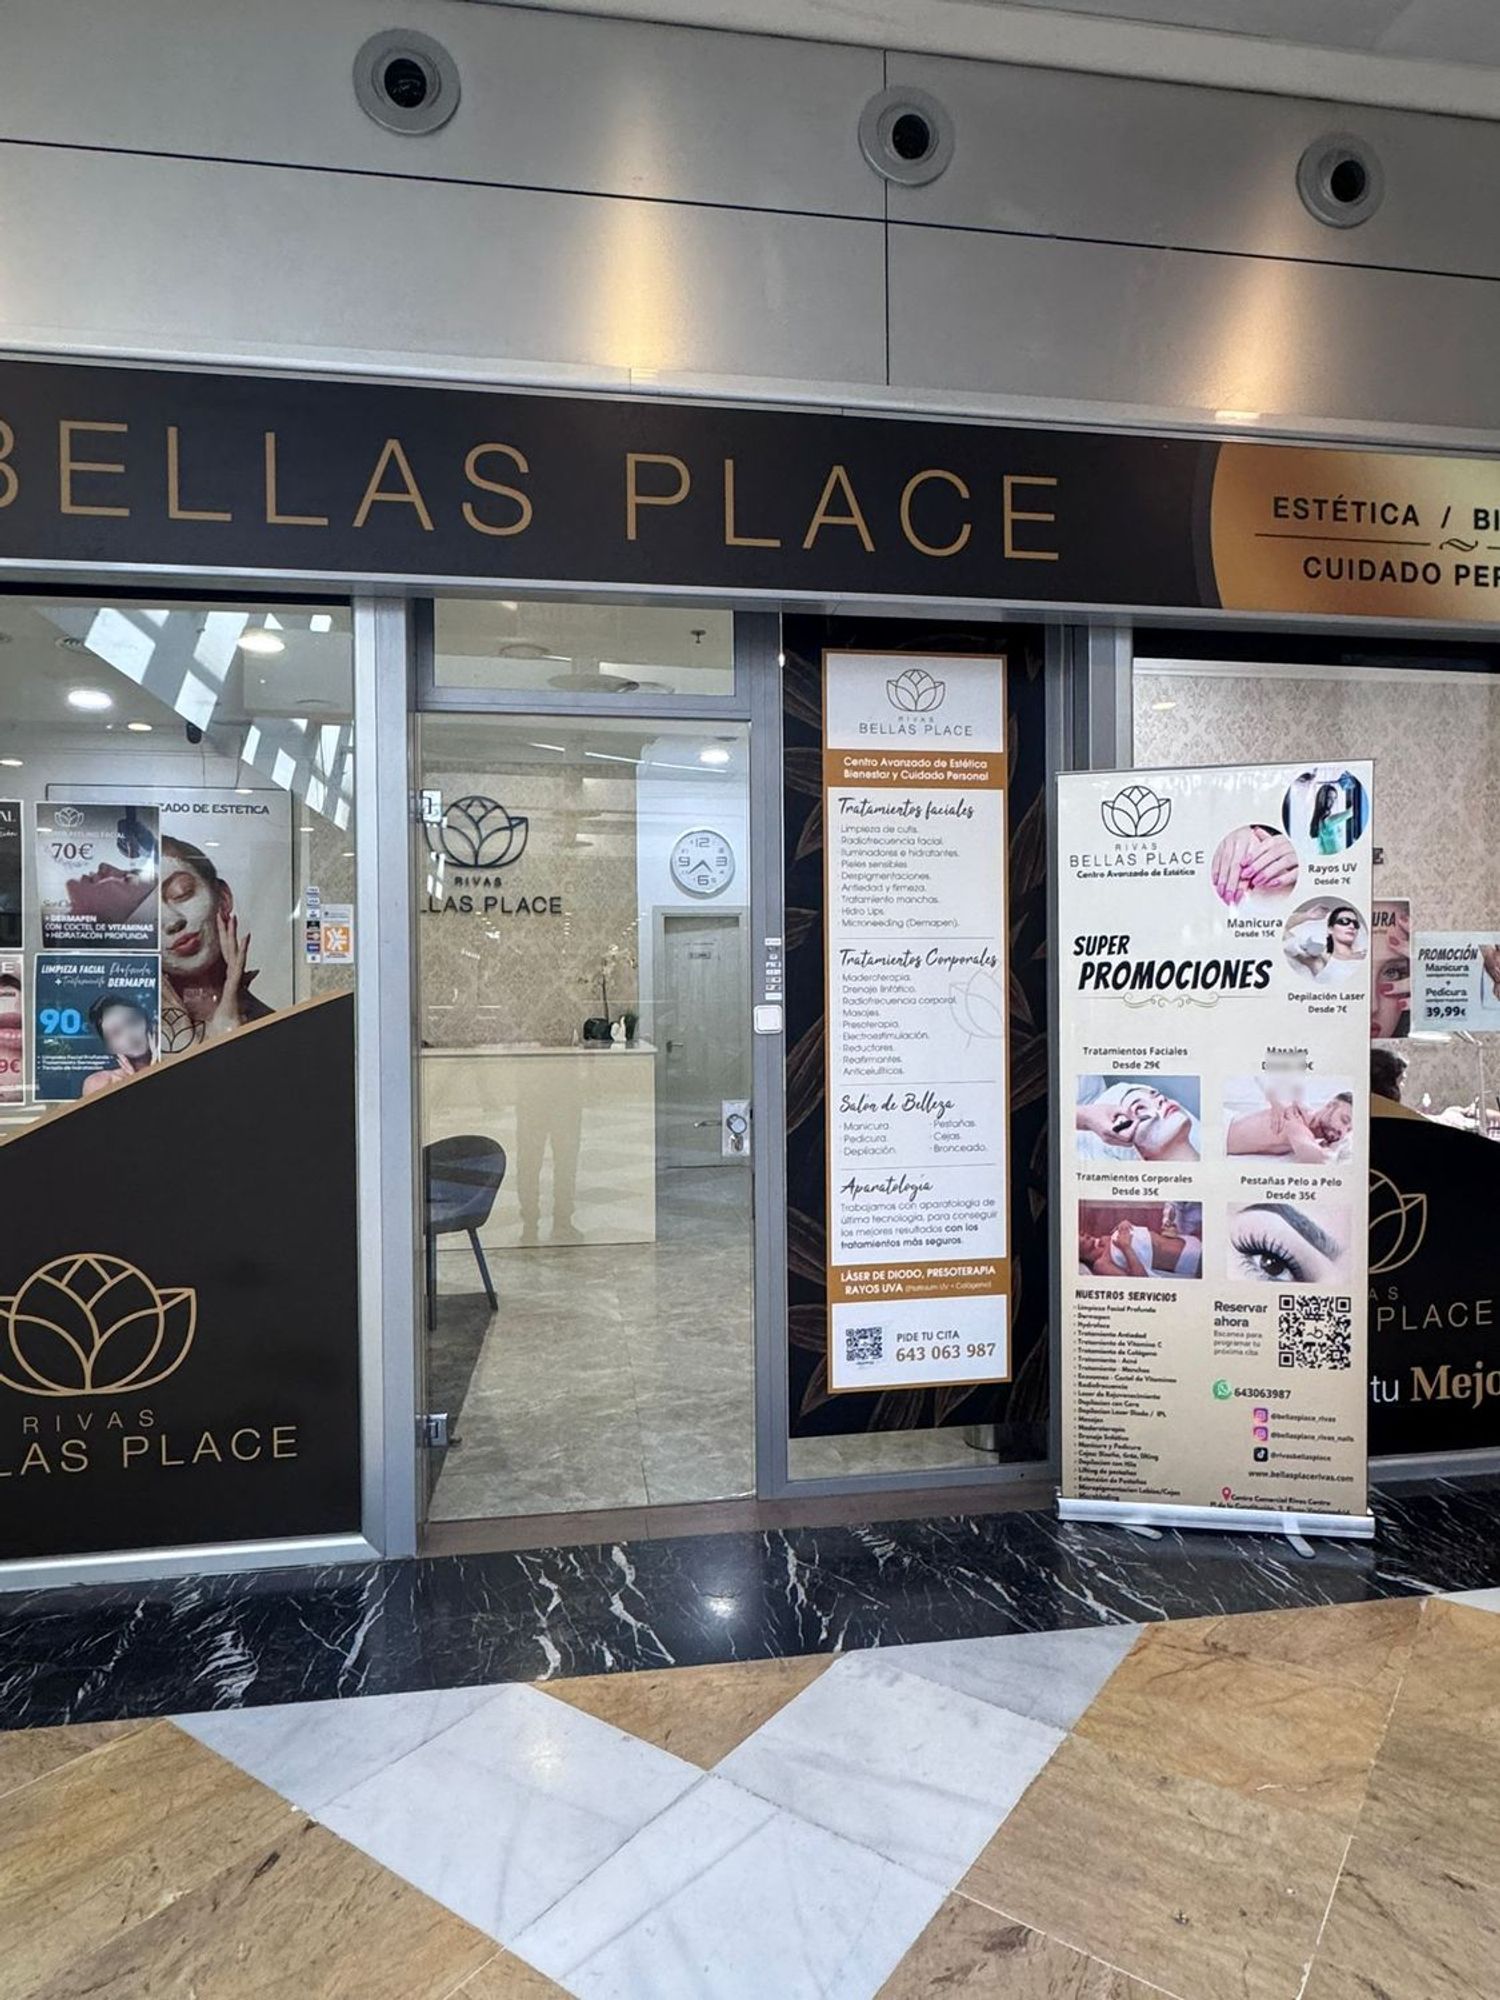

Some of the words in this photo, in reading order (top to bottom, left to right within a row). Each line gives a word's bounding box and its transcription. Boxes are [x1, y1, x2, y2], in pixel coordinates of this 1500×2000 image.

[626, 452, 1059, 560] PLACE
[1273, 494, 1420, 527] ESTÉTICA
[1303, 556, 1441, 585] CUIDADO
[859, 722, 917, 736] BELLAS
[924, 725, 973, 737] PLACE
[843, 757, 878, 768] Centro
[880, 757, 932, 769] Avanzado
[934, 758, 947, 768] de
[950, 758, 988, 770] Estética
[843, 769, 890, 779] Bienestar
[900, 770, 944, 780] Cuidado
[946, 771, 989, 781] Personal
[193, 804, 209, 813] DE
[838, 797, 922, 818] Tratamientos
[925, 798, 975, 820] faciales
[841, 824, 881, 834] Limpieza
[882, 824, 895, 833] de
[51, 842, 94, 860] 70€
[1115, 843, 1158, 851] RIVAS
[1070, 853, 1137, 868] BELLAS
[1146, 851, 1205, 865] PLACE
[1076, 869, 1105, 879] Centro
[1106, 869, 1149, 878] Avanzado
[1151, 868, 1161, 877] de
[1308, 863, 1340, 876] Rayos
[1342, 863, 1357, 873] UV
[454, 876, 502, 887] RIVAS
[1314, 877, 1338, 885] Desde
[1340, 876, 1351, 885] 7€
[484, 896, 562, 914] PLACE
[1226, 918, 1283, 928] Manicura
[1234, 930, 1259, 938] Desde
[1261, 930, 1276, 938] 15€
[1073, 935, 1131, 956] SUPER
[1418, 944, 1479, 960] PROMOCIÓN
[839, 948, 922, 969] Tratamientos
[925, 947, 997, 972] Corporales
[1425, 963, 1470, 971] Manicura
[1078, 959, 1273, 990] PROMOCIONES
[1287, 993, 1337, 1003] Depilación
[1339, 992, 1365, 1001] Laser
[1425, 988, 1467, 997] Pedicura
[1308, 1005, 1335, 1013] Desde
[1337, 1005, 1348, 1014] 7€
[1083, 1046, 1147, 1056] Tratamientos
[1149, 1047, 1188, 1056] Faciales
[1112, 1061, 1141, 1069] Desde
[1143, 1061, 1160, 1069] 29€
[881, 1093, 898, 1111] de
[901, 1090, 955, 1119] Belleza
[1076, 1172, 1139, 1183] Tratamientos
[1141, 1173, 1193, 1184] Corporales
[1241, 1175, 1286, 1187] Pestañas
[1287, 1176, 1310, 1186] Pelo
[1319, 1177, 1342, 1187] Pelo
[840, 1174, 933, 1202] Aparatología
[1112, 1187, 1141, 1195] Desde
[1143, 1187, 1159, 1196] 35€
[1266, 1190, 1296, 1199] Desde
[1299, 1191, 1316, 1200] 35€
[944, 1225, 963, 1233] con
[965, 1223, 979, 1232] los
[841, 1239, 900, 1250] tratamientos
[903, 1238, 923, 1247] más
[841, 1271, 870, 1283] LÁSER
[872, 1271, 885, 1281] DE
[926, 1265, 996, 1278] PRESOTERAPIA
[845, 1285, 880, 1296] RAYOS
[882, 1283, 903, 1294] UVA
[1075, 1289, 1125, 1300] NUESTROS
[1128, 1291, 1178, 1302] SERVICIOS
[1214, 1301, 1268, 1314] Reservar
[1214, 1316, 1249, 1328] ahora
[1377, 1300, 1493, 1332] PLACE
[897, 1332, 919, 1343] PIDE
[922, 1331, 934, 1341] TU
[937, 1330, 960, 1340] CITA
[896, 1347, 926, 1362] 643
[931, 1345, 961, 1360] 063
[966, 1342, 996, 1358] 987
[1234, 1388, 1291, 1399] 643063987
[1370, 1375, 1399, 1402] tu
[23, 1409, 155, 1434] RIVAS
[122, 1426, 298, 1468] PLACE
